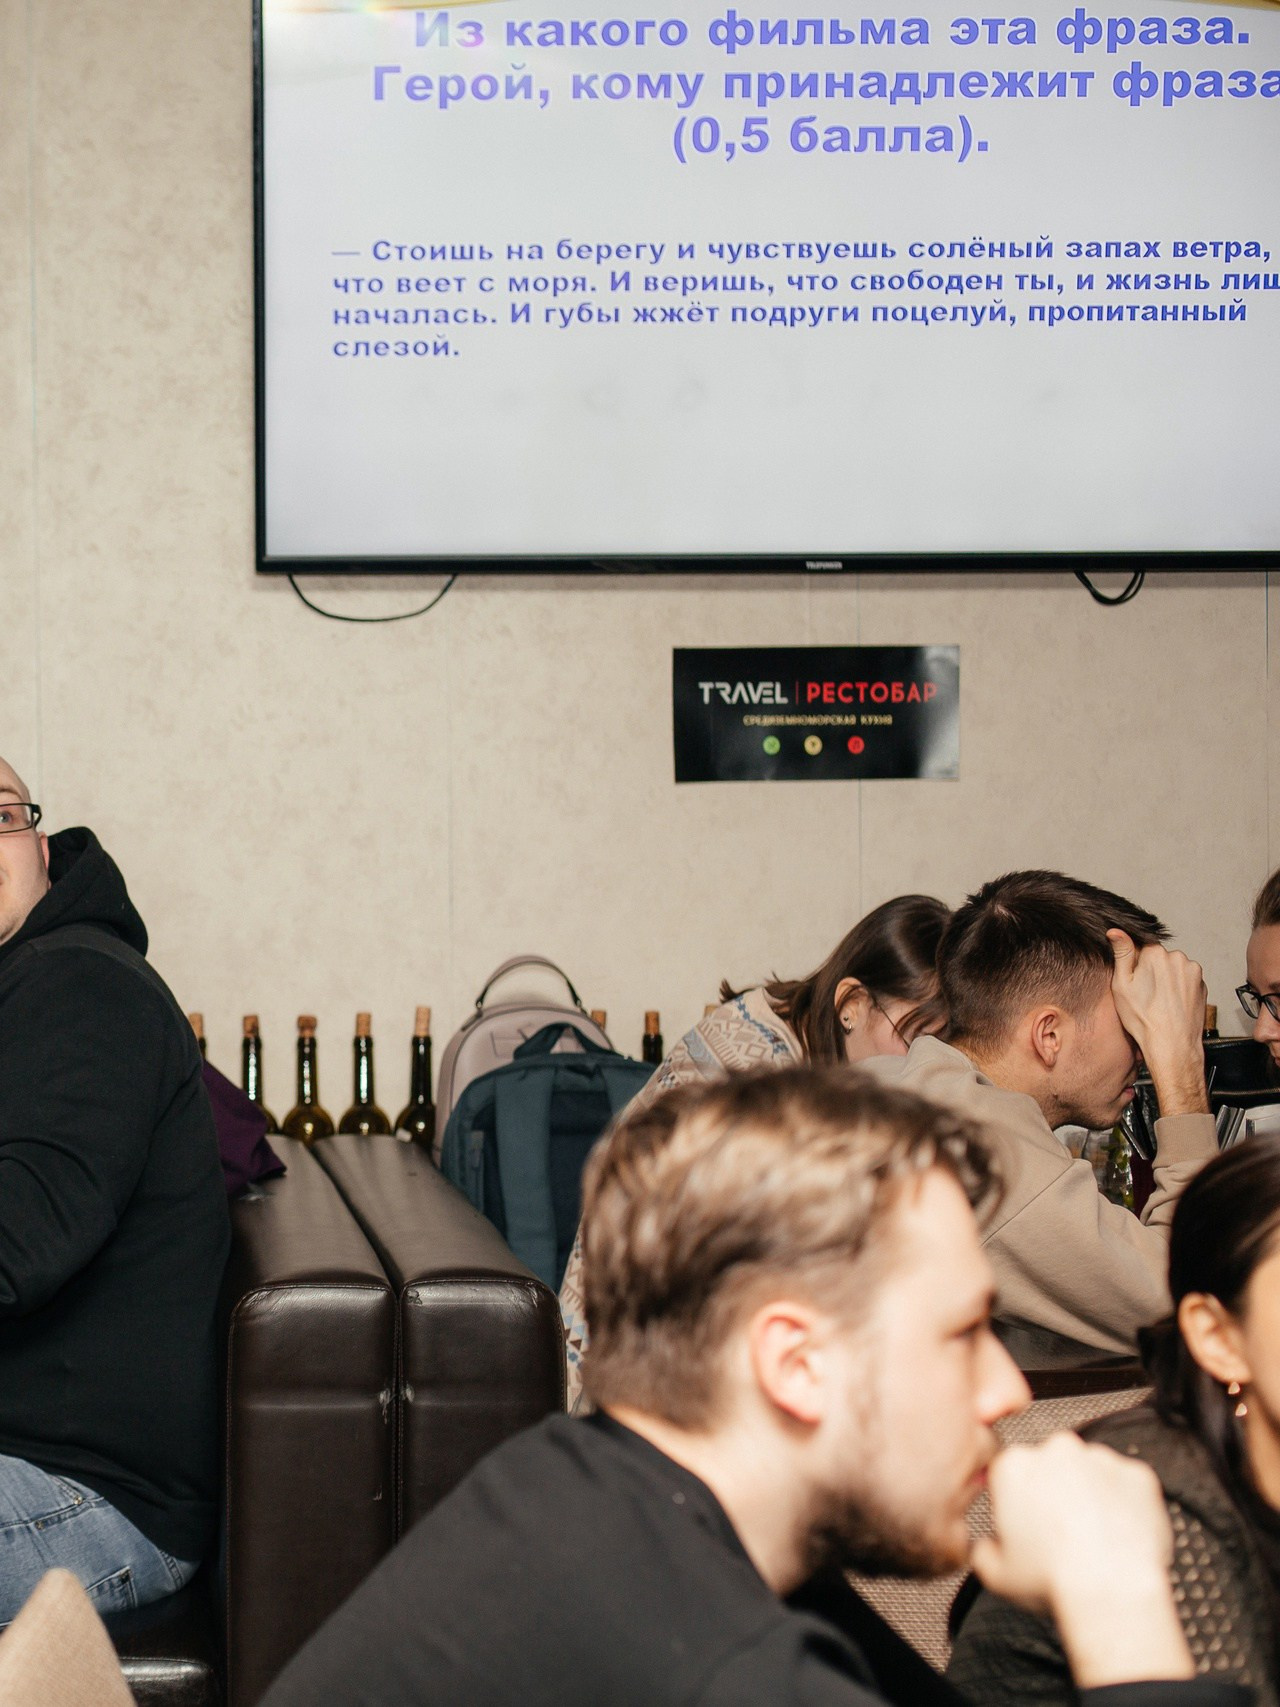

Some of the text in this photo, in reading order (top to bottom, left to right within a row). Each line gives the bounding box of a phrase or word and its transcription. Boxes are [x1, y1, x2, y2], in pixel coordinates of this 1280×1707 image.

[415, 7, 1250, 55] Из какого фильма эта фраза.
[373, 63, 550, 110] Герой,
[572, 72, 705, 109] кому
[723, 70, 1096, 108] принадлежит
[673, 115, 989, 164] (0,5 балла).
[372, 240, 494, 262] Стоишь
[506, 244, 545, 261] на
[556, 239, 666, 266] берегу
[677, 243, 697, 261] и
[707, 241, 897, 265] чувствуешь
[907, 236, 1055, 260] солёный
[1066, 241, 1162, 260] запах
[1172, 241, 1272, 264] ветра,
[333, 277, 385, 295] что
[397, 277, 466, 294] веет
[479, 277, 495, 294] с
[508, 277, 598, 298] моря.
[610, 271, 632, 293] И
[643, 275, 775, 297] веришь,
[787, 274, 840, 293] что
[850, 268, 1005, 296] свободен
[1015, 274, 1066, 295] ты,
[1076, 274, 1096, 291] и
[1106, 273, 1212, 291] жизнь
[333, 298, 1248, 330] началась. И губы жжёт подруги поцелуй, пропитанный
[332, 334, 461, 359] слезой.
[698, 681, 938, 705] TRAVEL РЕСТОБАР
